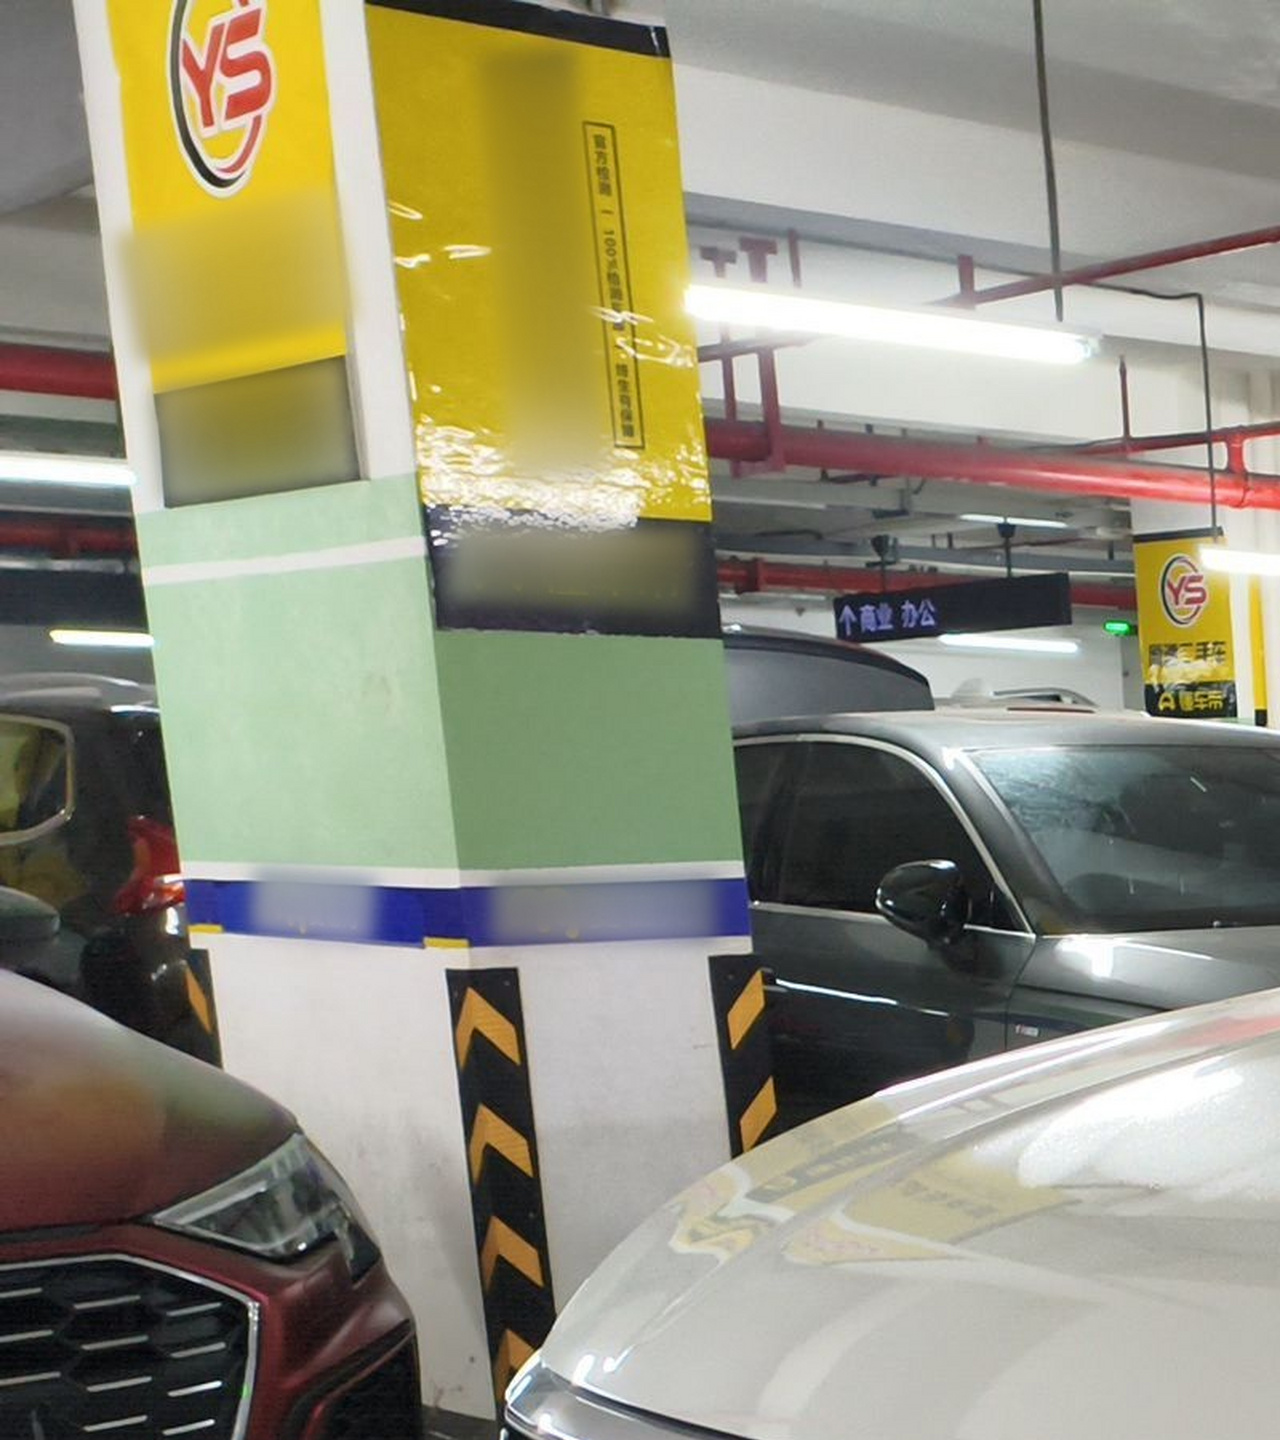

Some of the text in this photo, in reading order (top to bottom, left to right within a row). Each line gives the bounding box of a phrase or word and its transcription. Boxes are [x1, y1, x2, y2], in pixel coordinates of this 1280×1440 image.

[182, 8, 272, 128] YS
[1167, 574, 1207, 606] YS
[859, 600, 936, 632] 商业 办公
